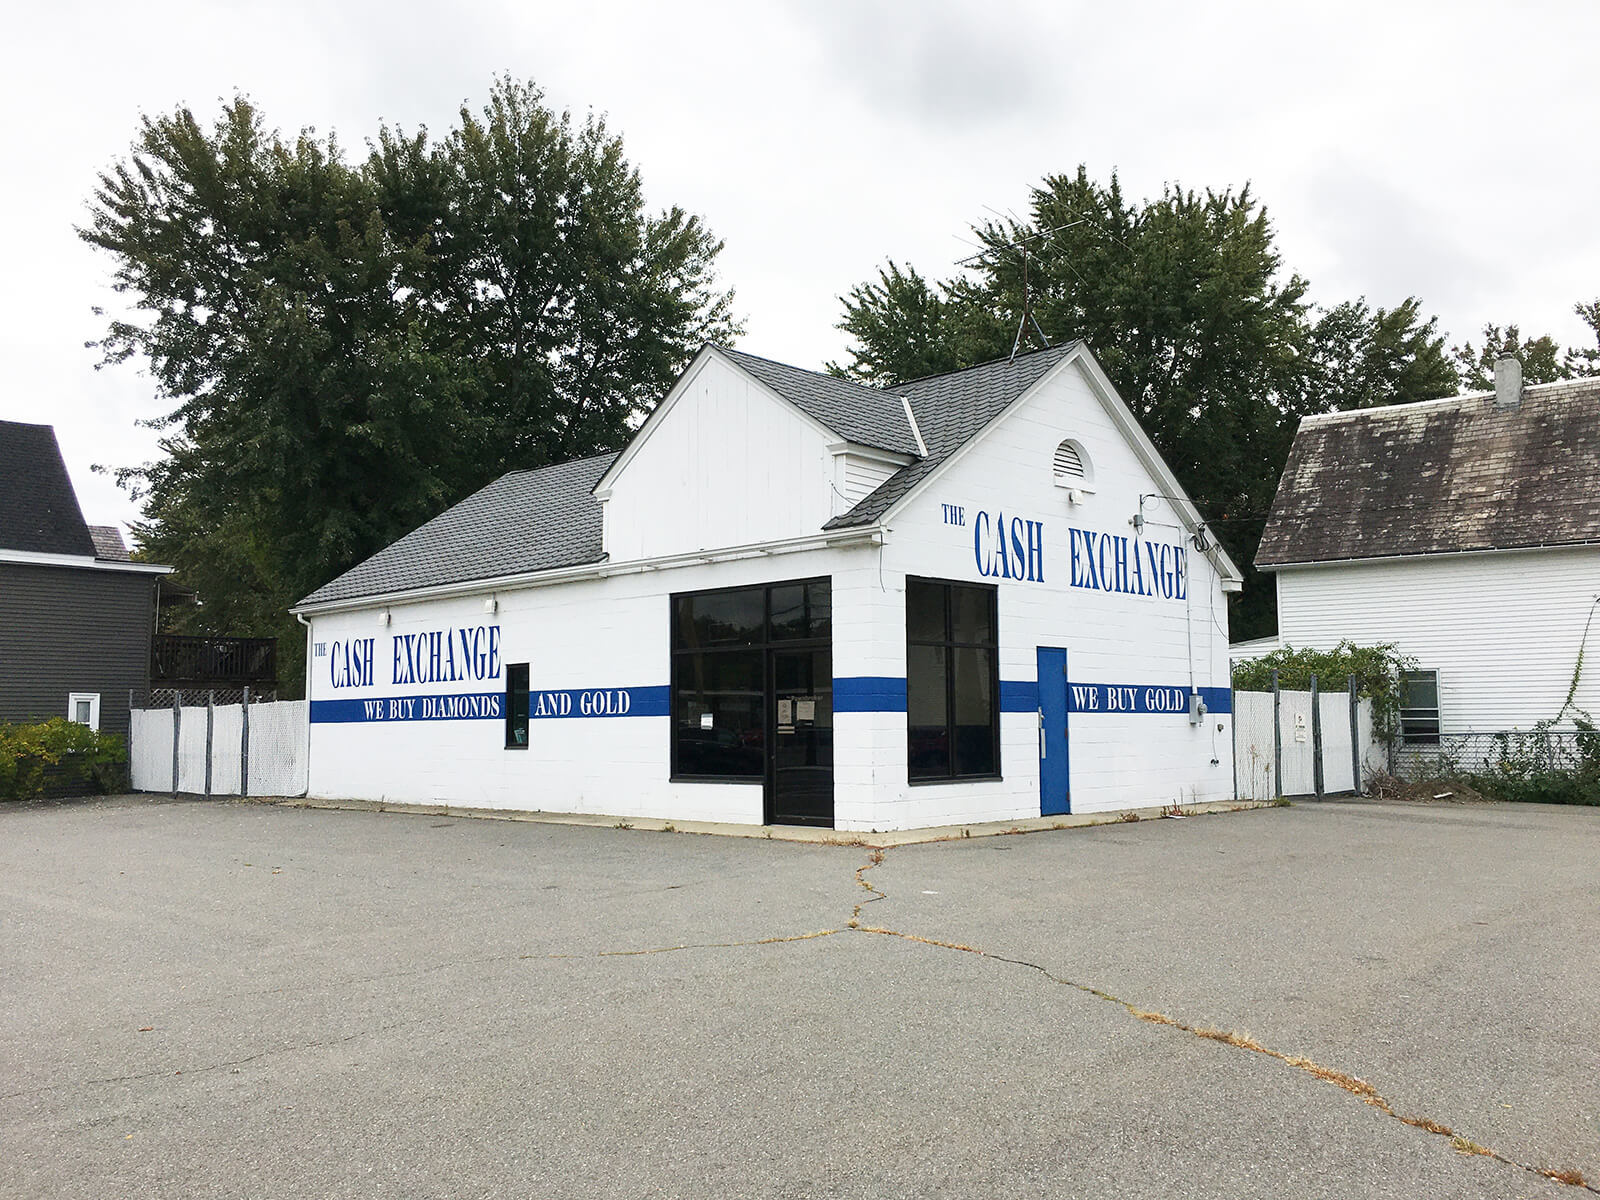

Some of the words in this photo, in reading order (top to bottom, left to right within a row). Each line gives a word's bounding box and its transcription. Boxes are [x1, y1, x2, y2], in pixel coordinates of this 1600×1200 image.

[941, 503, 966, 527] THE
[974, 510, 1045, 583] CASH
[1068, 527, 1187, 600] EXCHANGE
[314, 642, 327, 657] THE
[331, 637, 375, 688] CASH
[392, 625, 501, 685] EXCHANGE
[364, 700, 384, 720] WE
[389, 698, 415, 719] BUY
[421, 695, 500, 718] DIAMONDS
[534, 693, 572, 716] AND
[580, 690, 630, 715] GOLD
[1072, 686, 1099, 710] WE
[1107, 687, 1138, 711] BUY
[1145, 688, 1184, 711] GOLD
